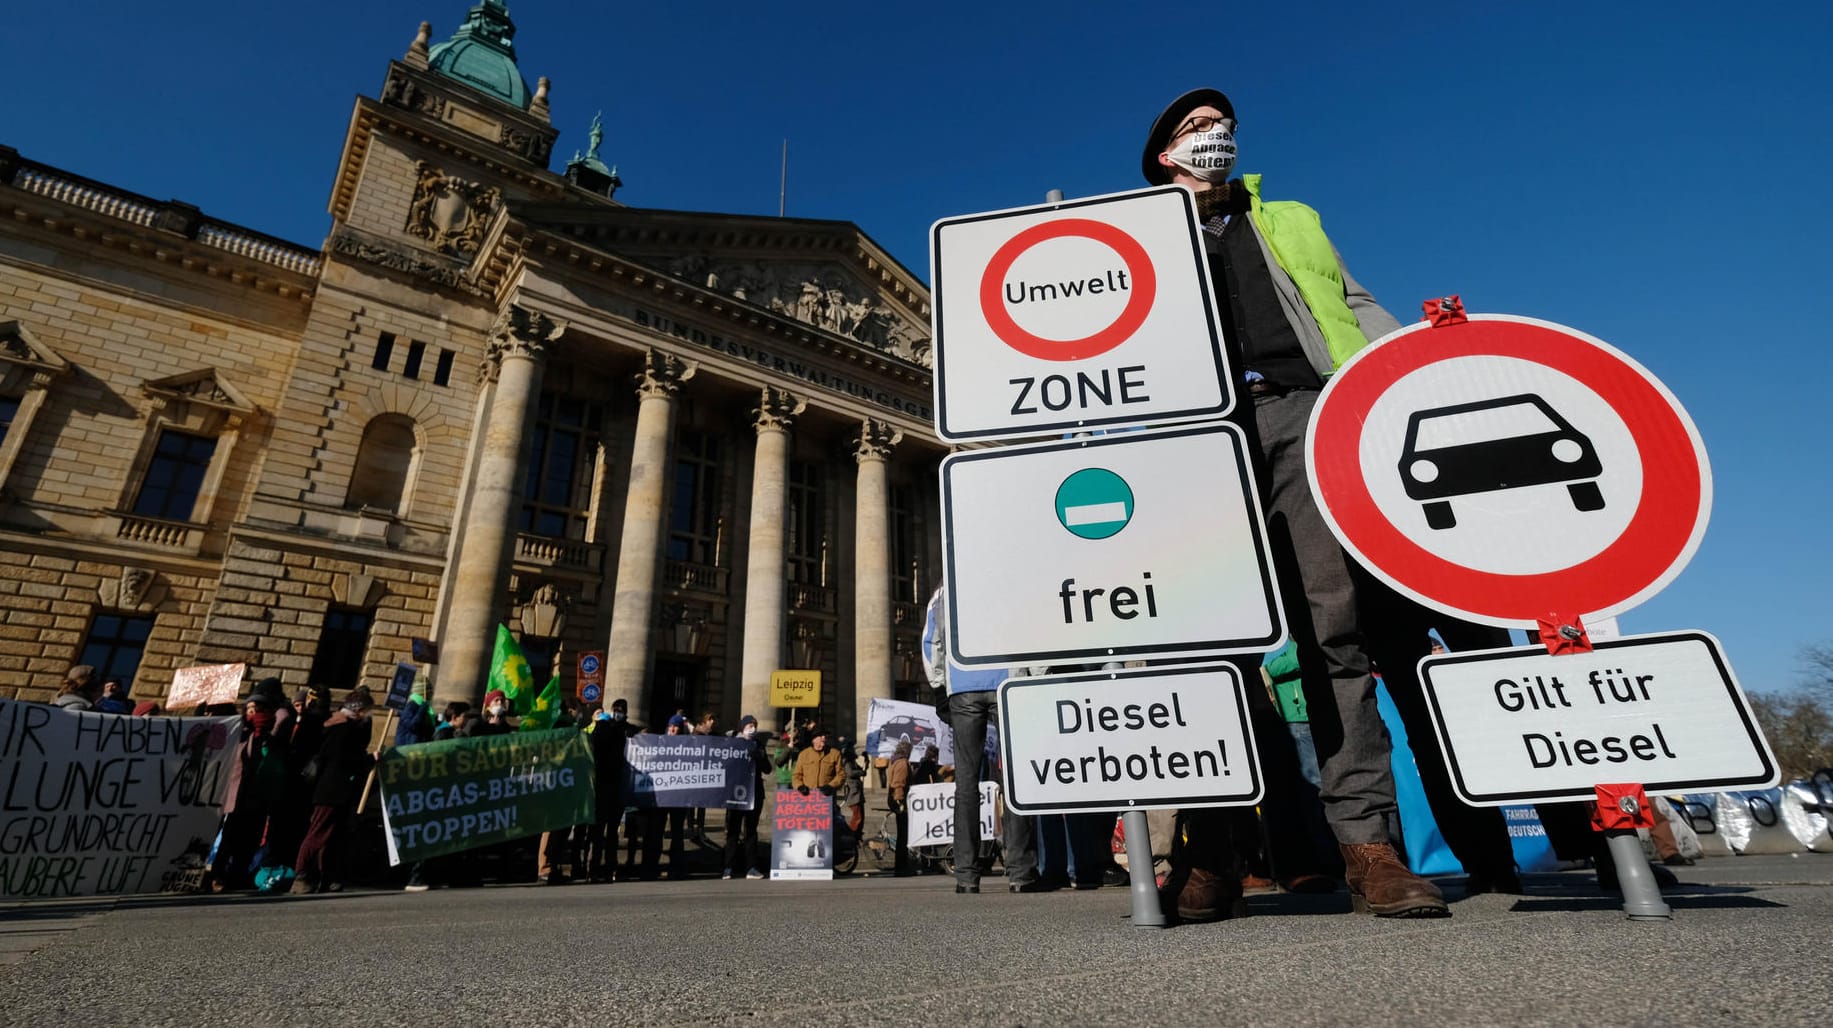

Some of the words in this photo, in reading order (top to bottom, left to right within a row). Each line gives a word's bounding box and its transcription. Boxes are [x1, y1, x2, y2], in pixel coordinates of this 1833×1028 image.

[1006, 270, 1129, 304] Umwelt
[1009, 365, 1150, 415] ZONE
[1059, 571, 1158, 624] frei
[776, 677, 814, 692] Leipzig
[1493, 676, 1572, 712] Gilt
[1588, 668, 1655, 704] für
[0, 703, 50, 757] IR
[75, 711, 184, 755] HABEN
[1055, 692, 1187, 735] Diesel
[385, 750, 449, 785] FÜR
[633, 744, 706, 757] Tausendmal
[709, 746, 751, 762] regiert,
[707, 760, 723, 770] ist
[1030, 739, 1231, 785] verboten!
[1522, 723, 1677, 769] Diesel
[3, 757, 144, 813] LUNGE
[387, 767, 576, 817] ABGAS-BETRUG
[391, 805, 518, 850] STOPPEN!
[776, 802, 830, 816] ABGASE
[925, 815, 993, 840] lebn!
[0, 813, 179, 855] GRUNDRECHT
